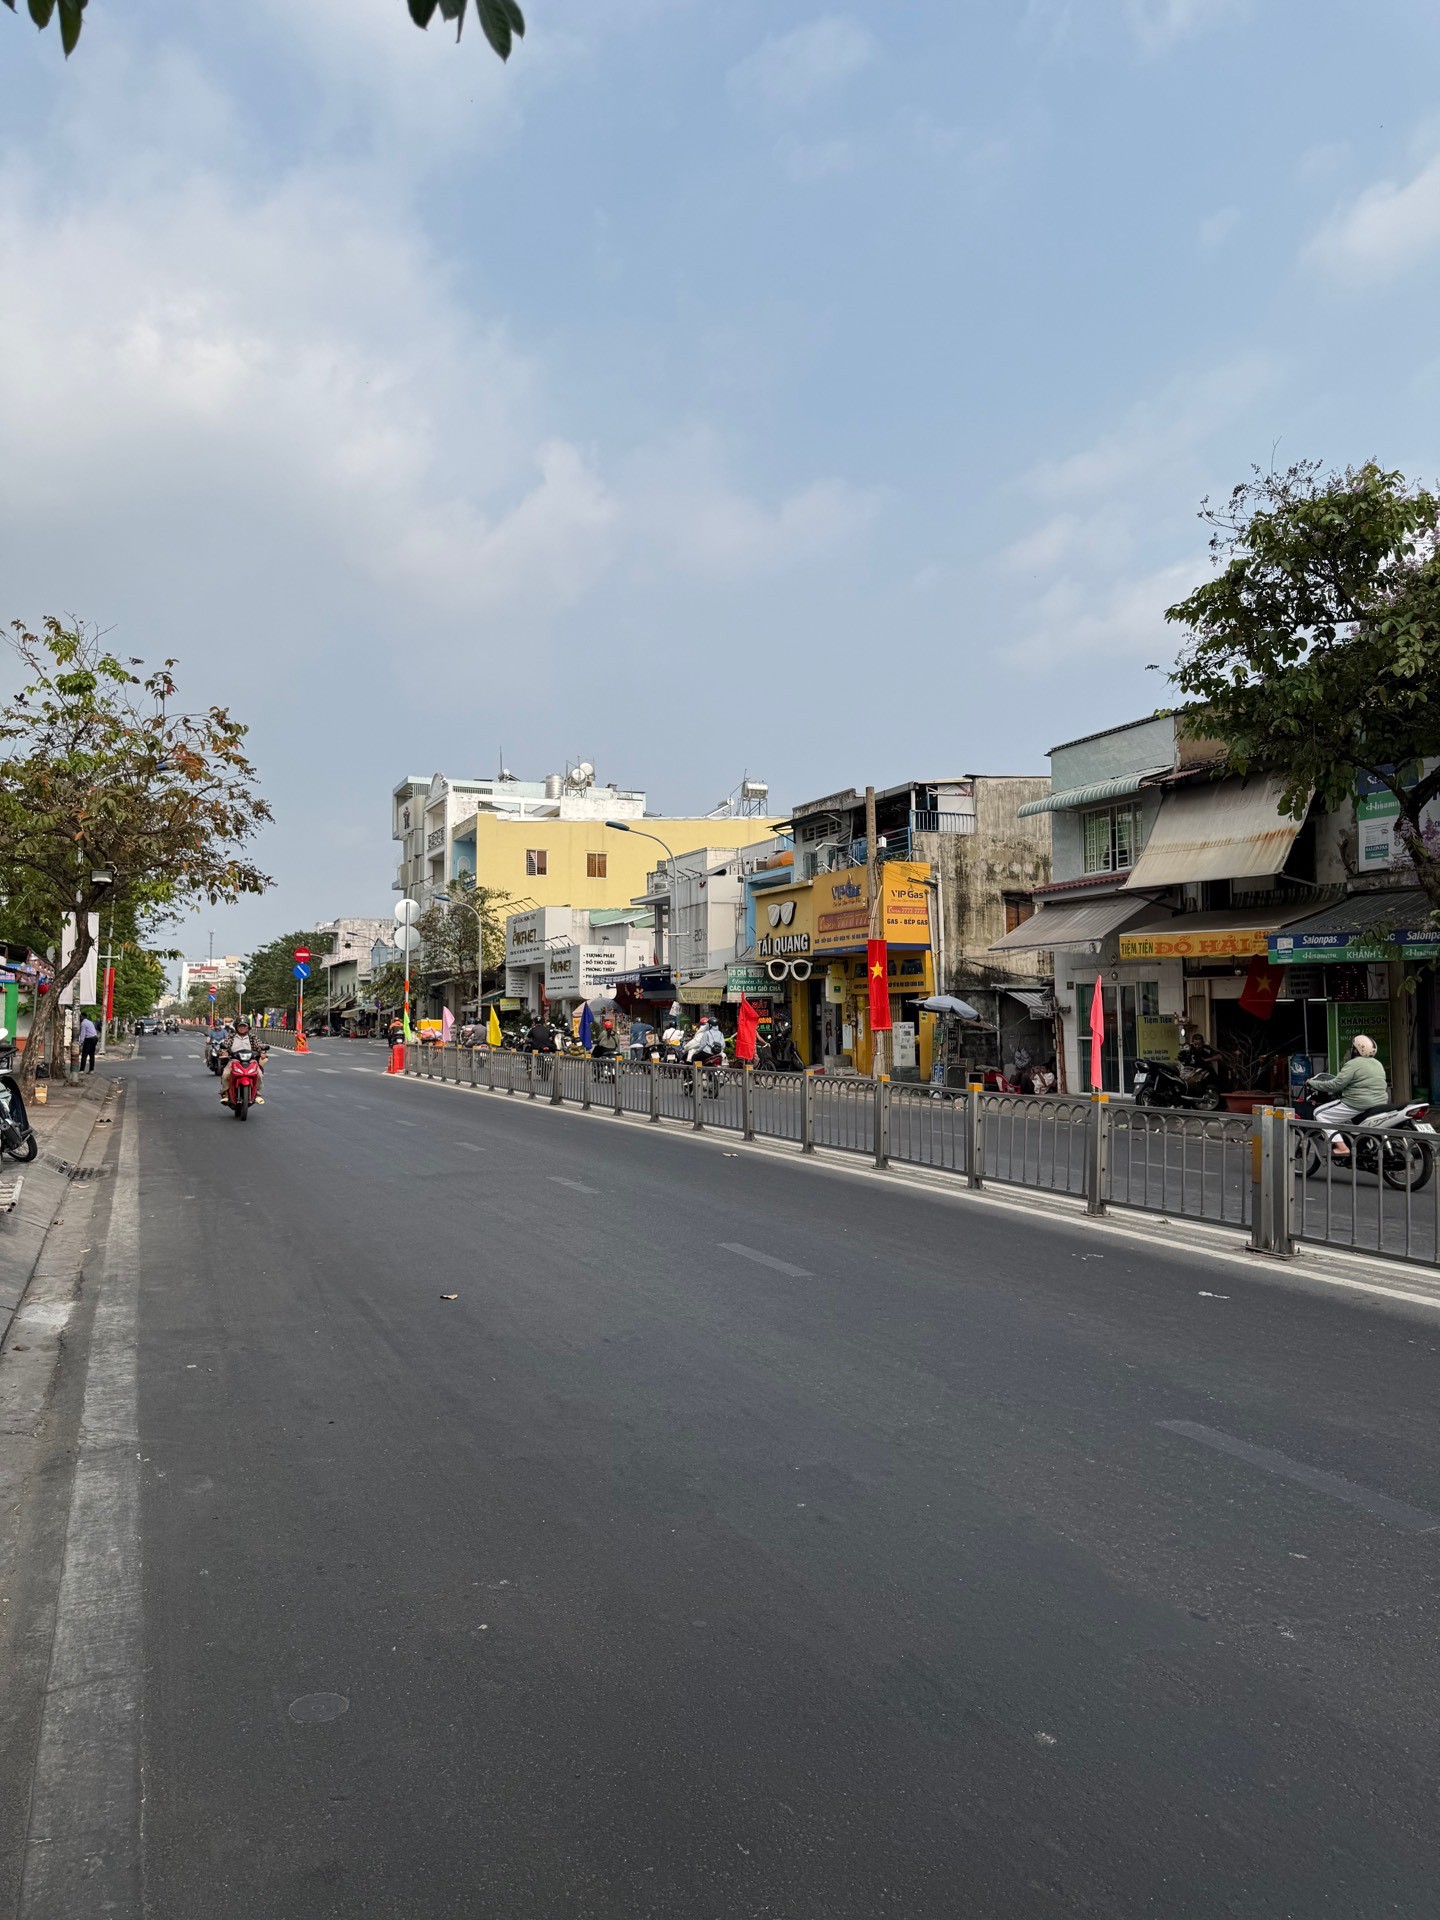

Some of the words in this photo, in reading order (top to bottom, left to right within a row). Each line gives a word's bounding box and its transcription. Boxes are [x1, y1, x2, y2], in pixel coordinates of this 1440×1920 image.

[891, 889, 906, 898] VIP
[907, 890, 924, 899] Gas
[774, 934, 808, 955] QUANG
[1121, 940, 1137, 956] TIỆM
[1138, 939, 1154, 956] TIỆN
[1155, 935, 1194, 955] ĐỖ
[1198, 935, 1250, 953] HẢI
[729, 984, 741, 992] CÁC
